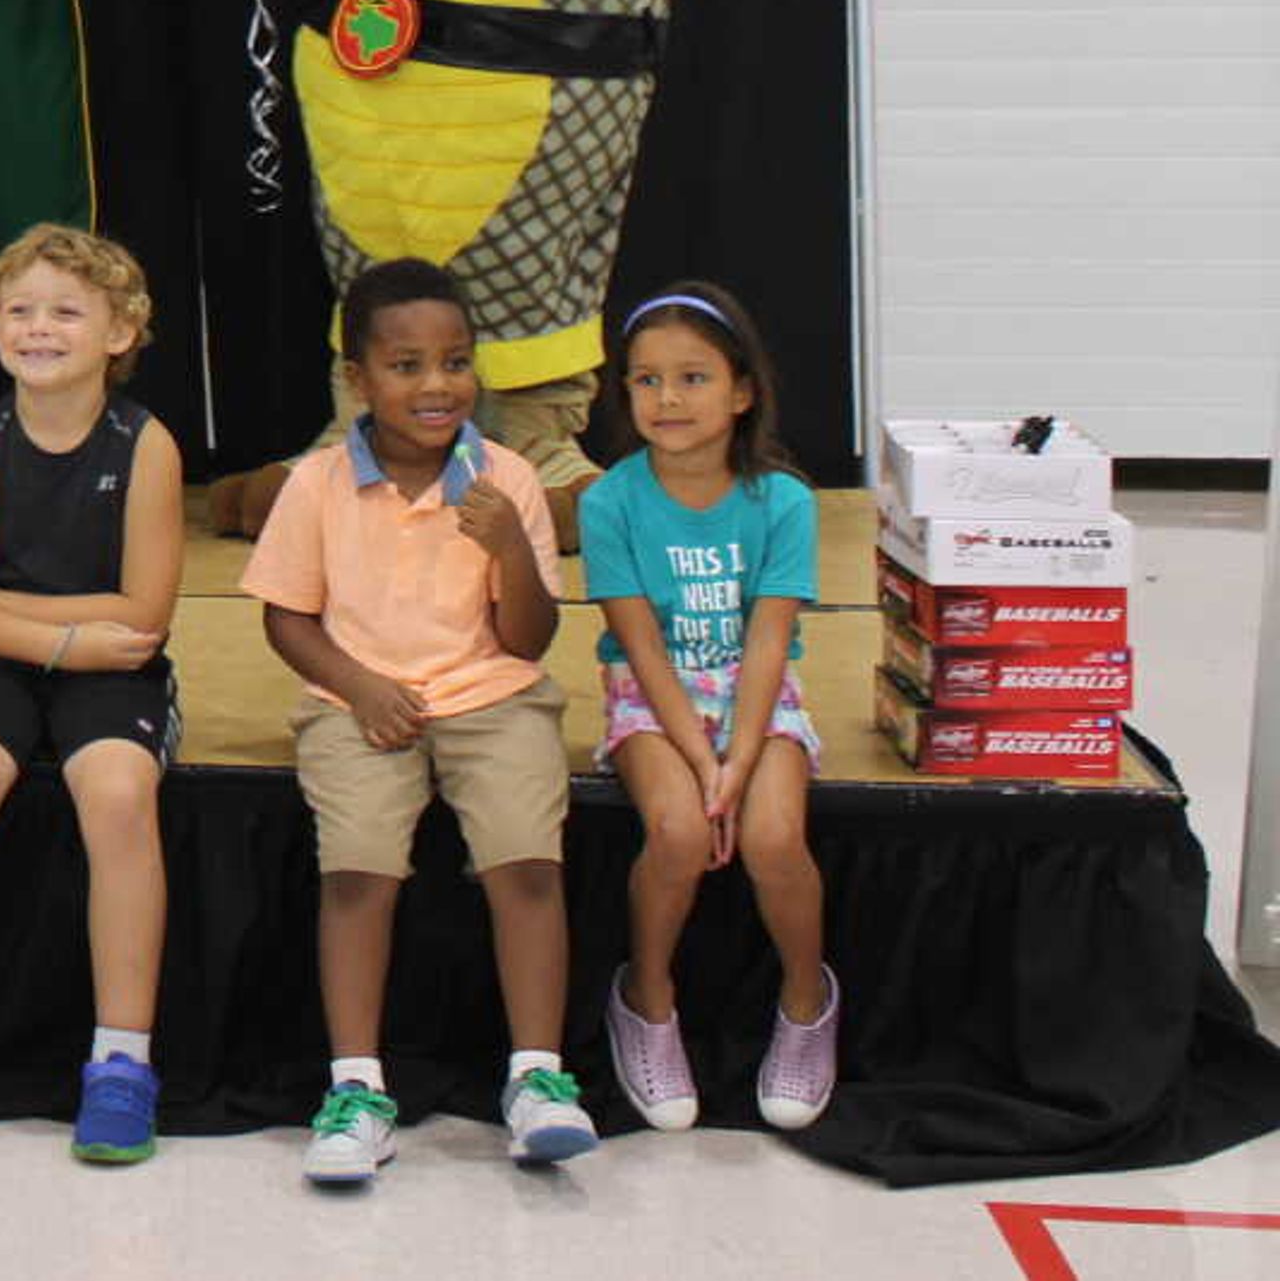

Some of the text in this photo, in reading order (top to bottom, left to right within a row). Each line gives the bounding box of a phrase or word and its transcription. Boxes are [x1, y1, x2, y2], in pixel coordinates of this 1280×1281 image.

[665, 542, 745, 576] THIS I
[993, 606, 1125, 623] BASEBALLS
[997, 673, 1130, 689] BASEBALLS
[984, 739, 1116, 755] BASEBALLS
